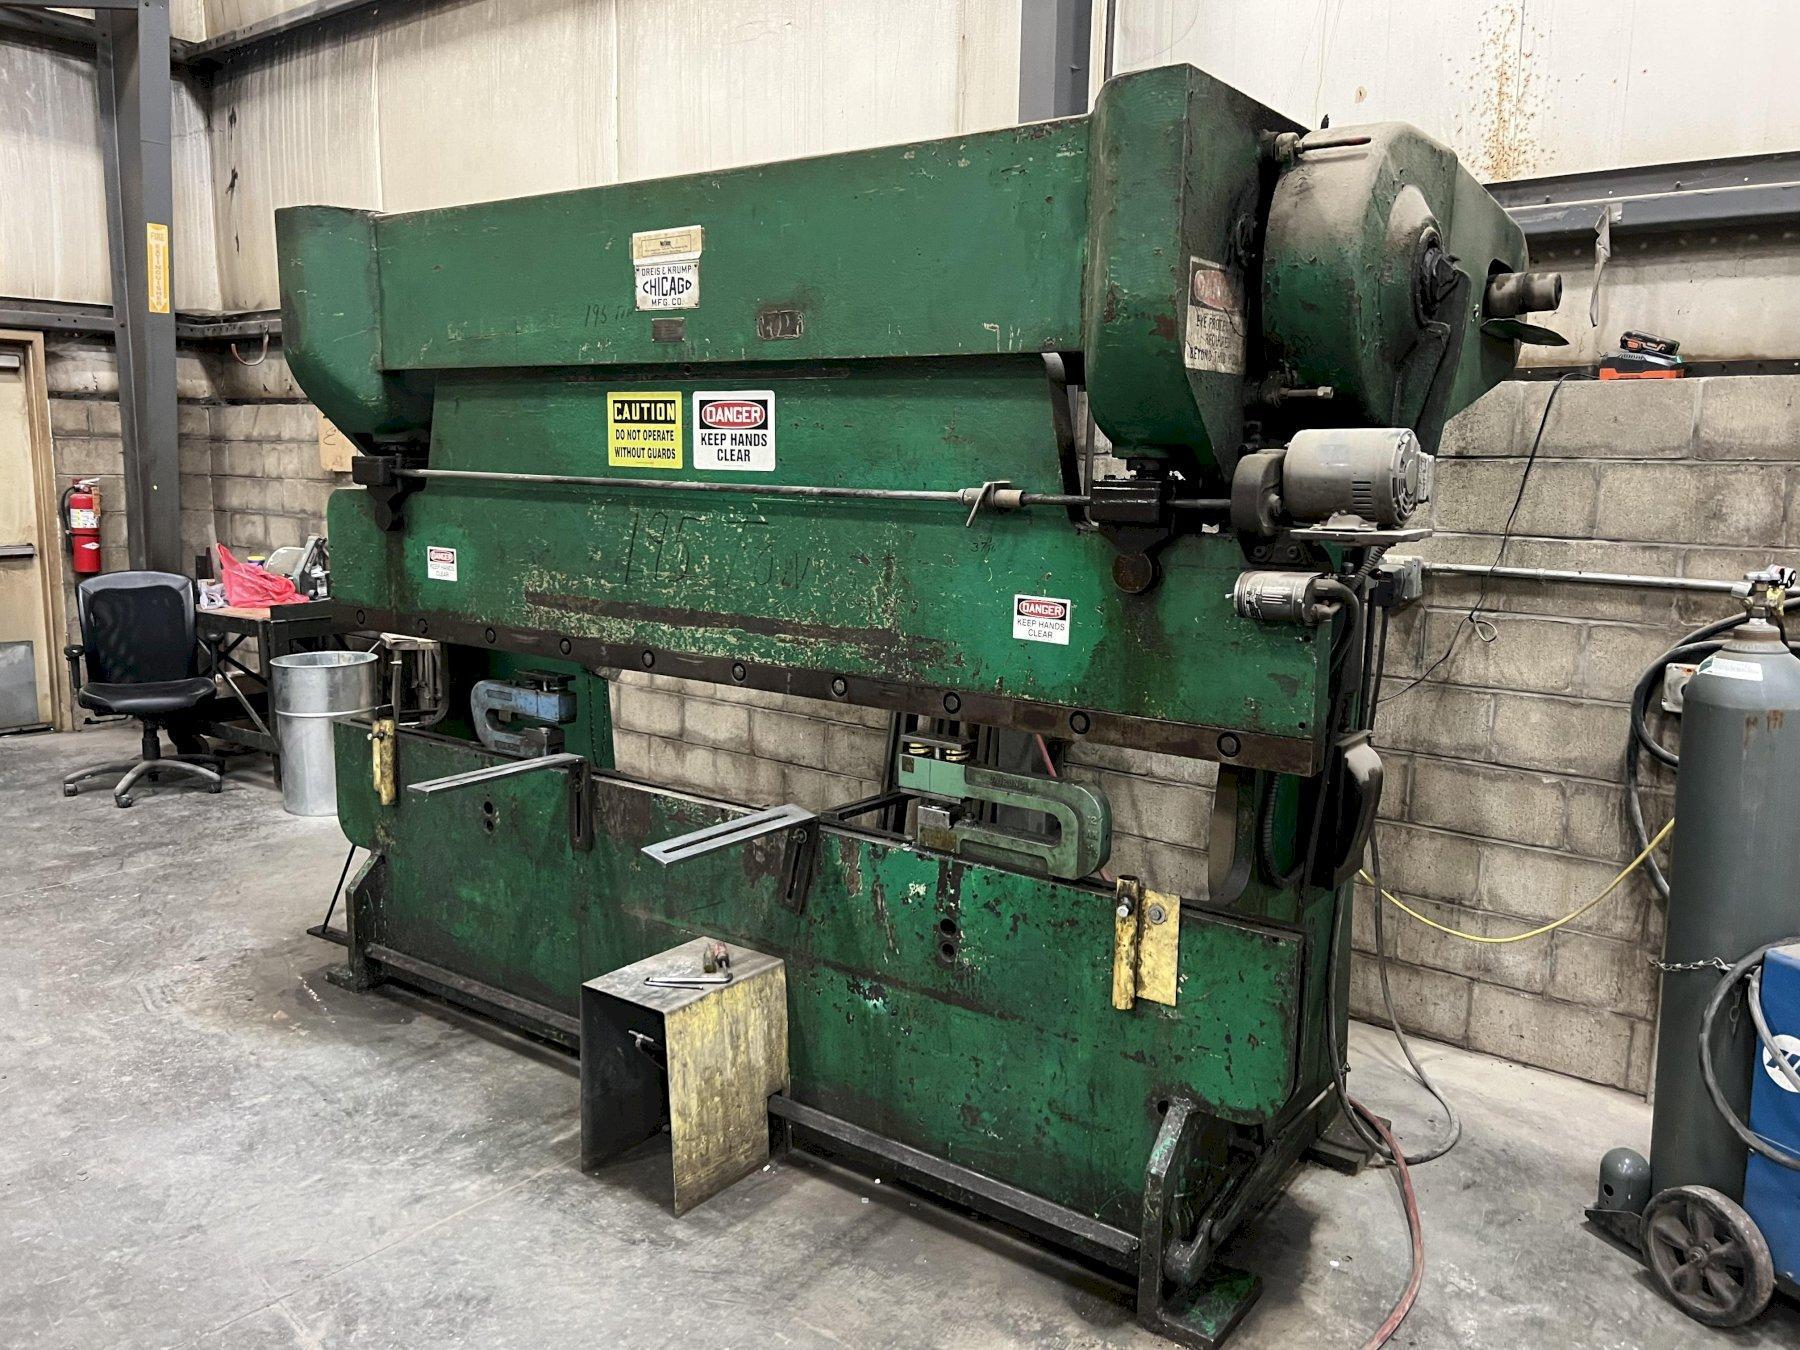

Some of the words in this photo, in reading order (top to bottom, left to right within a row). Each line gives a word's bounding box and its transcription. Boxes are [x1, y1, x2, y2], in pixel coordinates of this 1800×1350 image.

[641, 267, 661, 277] DREIS
[667, 265, 692, 275] KRUMP
[643, 276, 692, 297] CHICAGO
[651, 298, 670, 307] MFG.
[671, 297, 684, 306] CO.
[613, 402, 676, 421] CAUTION
[706, 406, 762, 423] DANGER
[615, 429, 625, 441] DO
[627, 429, 641, 441] NOT
[642, 430, 675, 442] OPERATE
[700, 432, 727, 446] KEEP
[730, 433, 768, 447] HANDS
[614, 446, 646, 459] WITHOUT
[647, 447, 676, 460] GUARDS
[717, 448, 751, 462] CLEAR
[1022, 602, 1063, 616] DANGER
[1017, 618, 1037, 627] KEEP
[1038, 621, 1065, 631] HANDS
[1027, 628, 1053, 638] CLEAR
